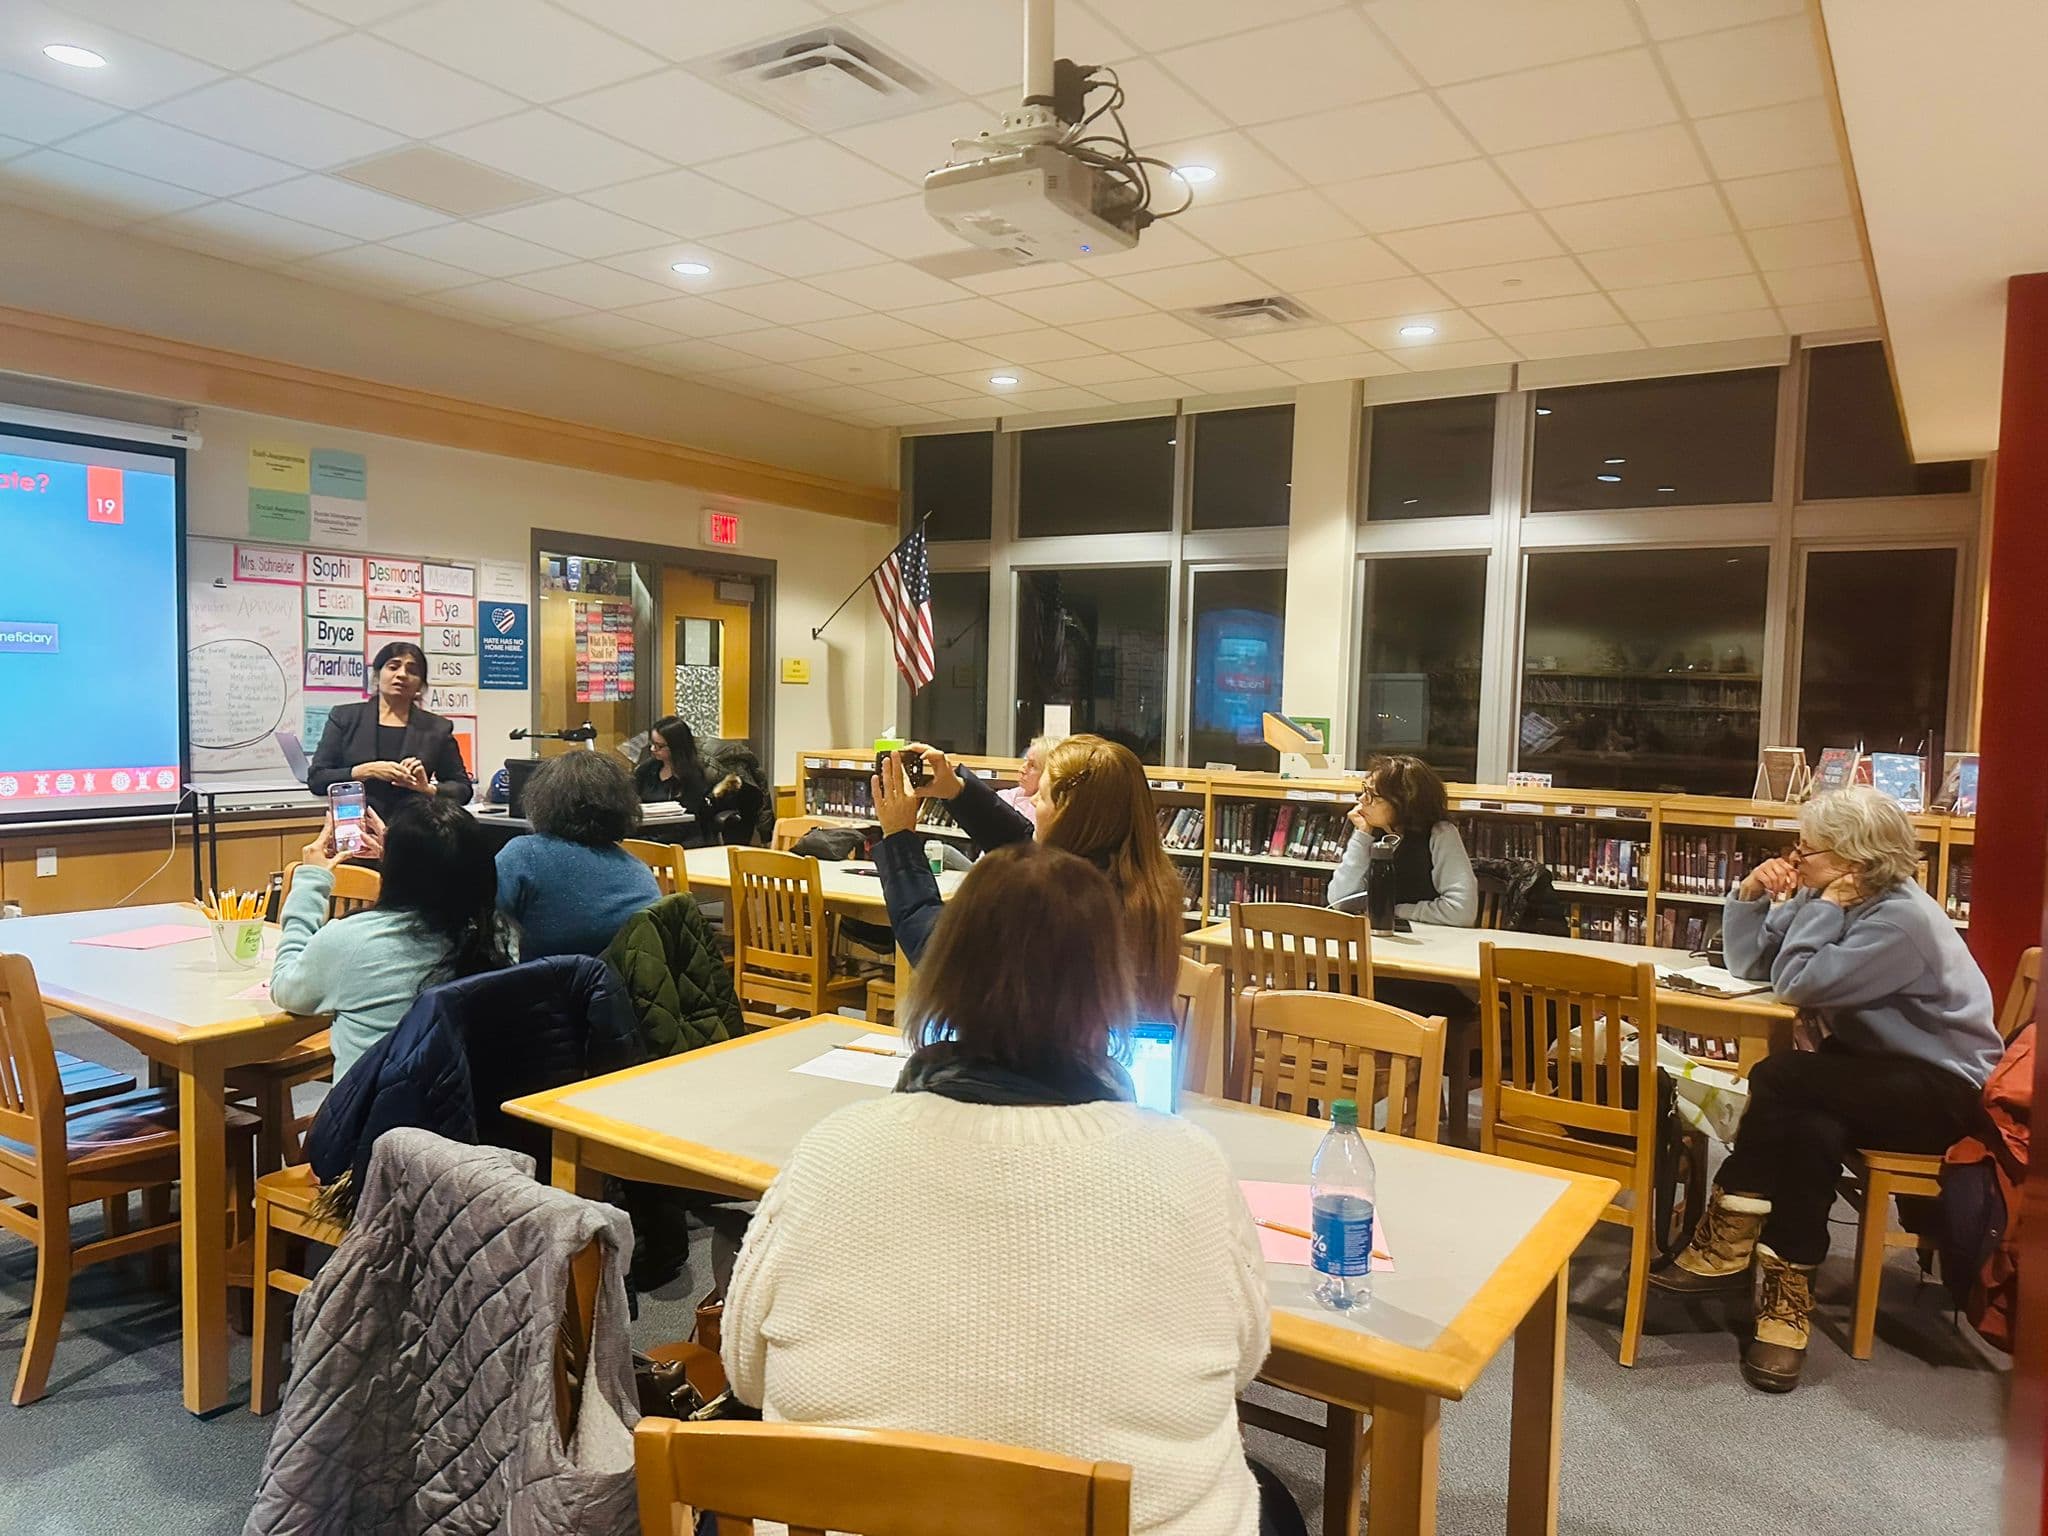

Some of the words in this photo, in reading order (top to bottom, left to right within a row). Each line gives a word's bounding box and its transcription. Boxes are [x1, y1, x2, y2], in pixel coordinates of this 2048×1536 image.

[96, 498, 116, 515] 19
[712, 514, 737, 544] EXIT
[240, 554, 257, 571] Mrs.
[259, 557, 295, 574] Schneider
[368, 561, 420, 584] Desmond
[0, 631, 53, 646] neficiary
[318, 620, 354, 645] Bryce
[442, 629, 460, 647] Sid
[514, 638, 524, 646] NO
[308, 653, 362, 677] Charlotte
